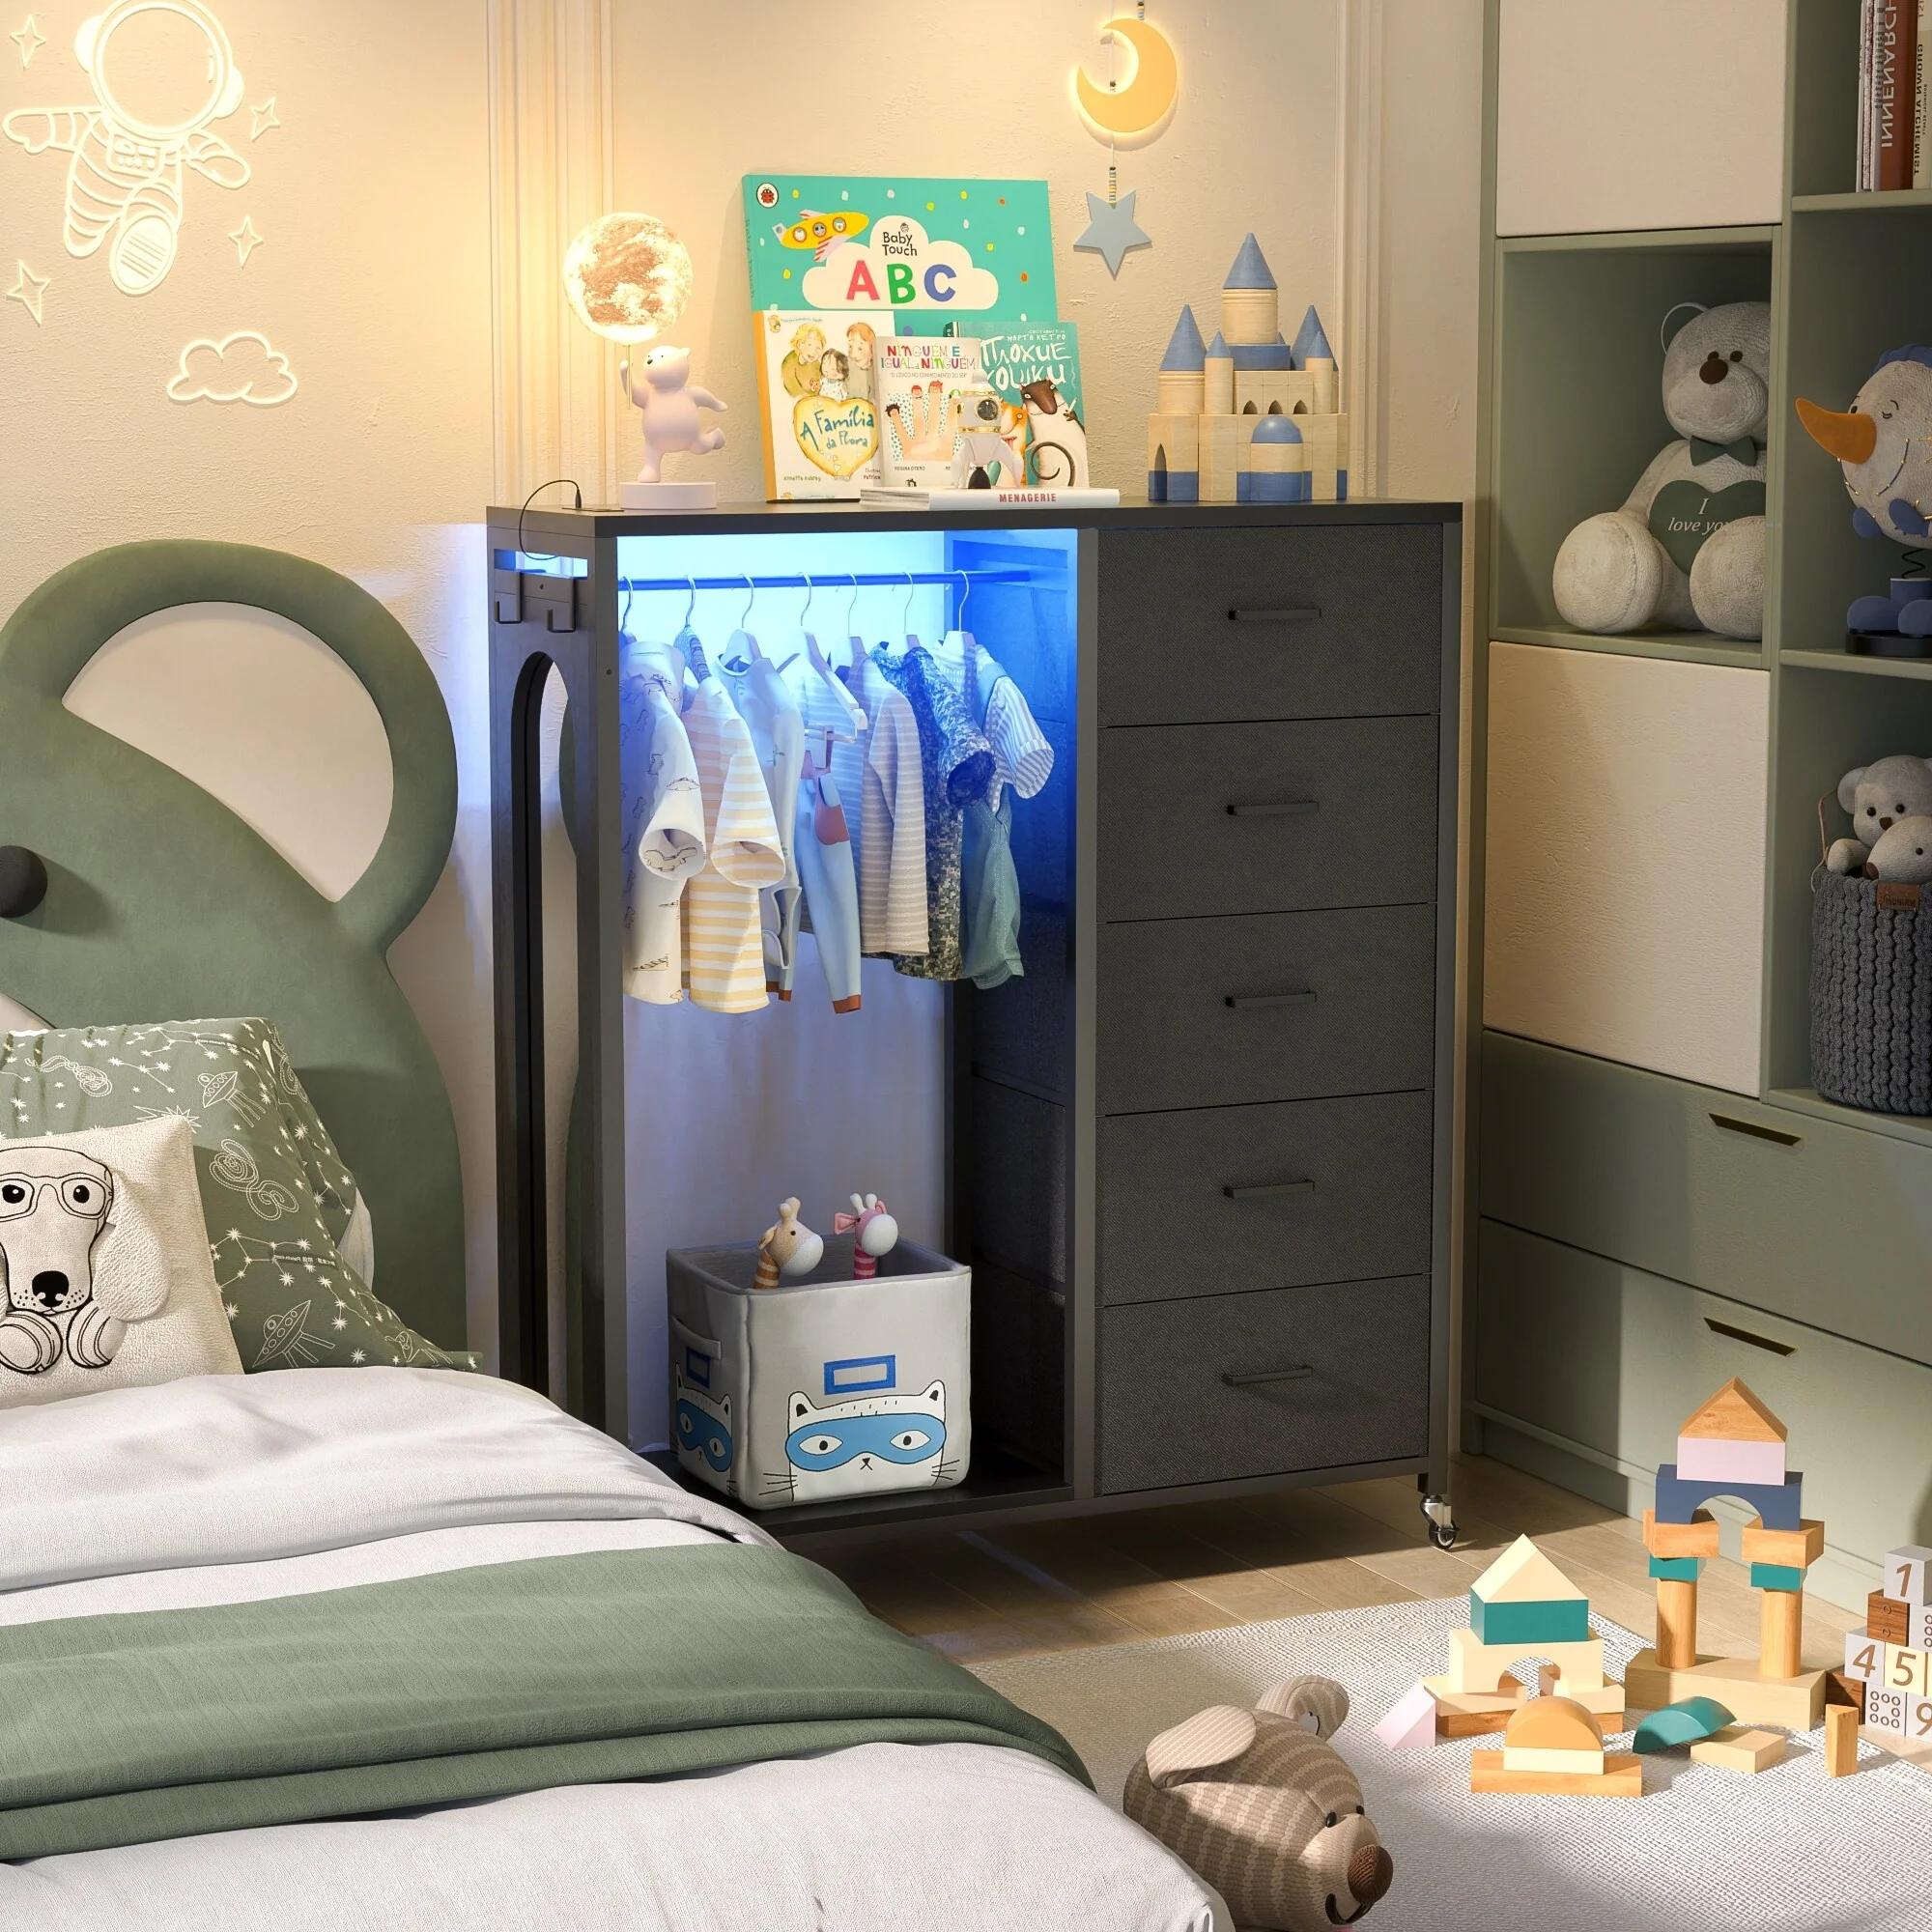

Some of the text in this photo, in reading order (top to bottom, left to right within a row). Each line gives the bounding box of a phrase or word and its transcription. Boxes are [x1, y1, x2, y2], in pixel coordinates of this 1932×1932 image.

[882, 231, 913, 246] Baby
[882, 243, 918, 256] Touch
[845, 259, 957, 304] ABC
[800, 405, 874, 451] A Família
[826, 430, 868, 449] da Flora
[999, 493, 1057, 503] MENAGERIE
[1698, 497, 1709, 515] I
[1667, 517, 1729, 536] love yo
[1895, 1563, 1913, 1598] 1
[1852, 1644, 1917, 1687] 4 5
[1916, 1702, 1932, 1737] 9
